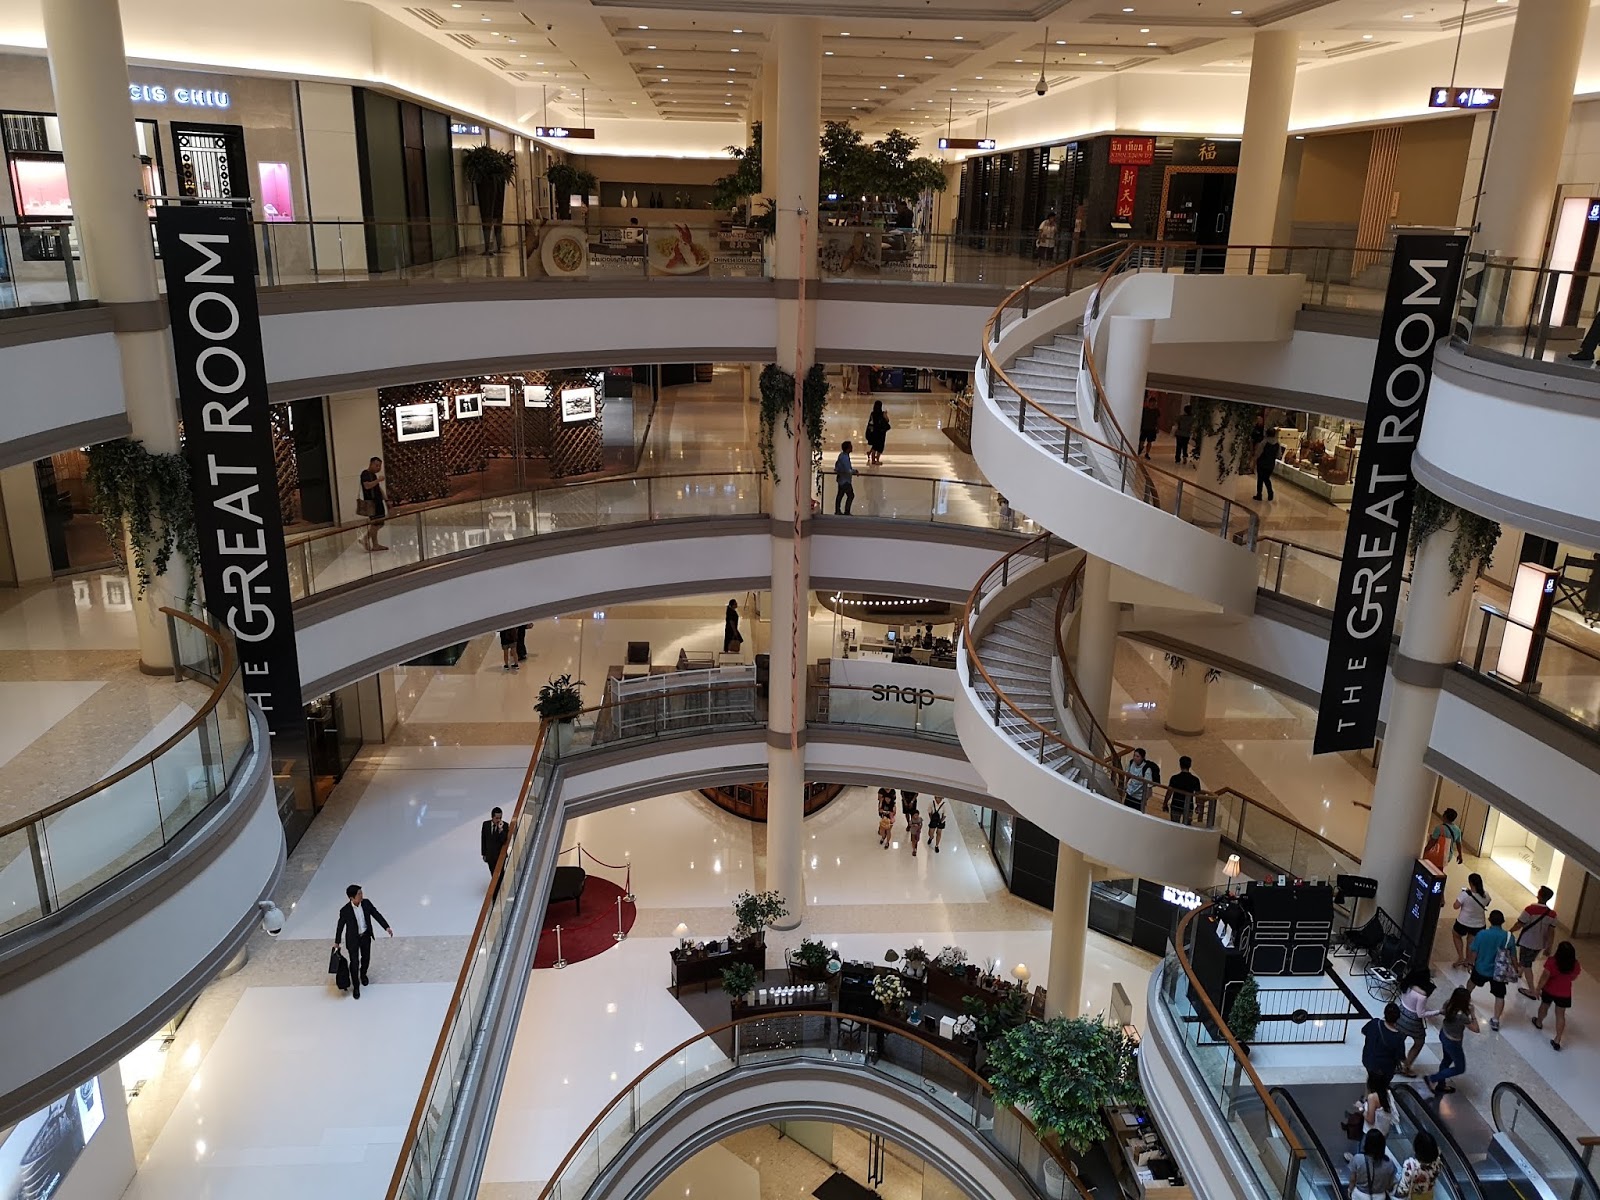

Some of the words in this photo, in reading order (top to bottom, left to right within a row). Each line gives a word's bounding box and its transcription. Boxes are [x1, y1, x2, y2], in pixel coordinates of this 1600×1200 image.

[174, 88, 230, 109] CHIU
[1198, 142, 1217, 161] 福
[1119, 170, 1135, 217] 新天地
[178, 233, 253, 432] ROOM
[1377, 260, 1449, 443] ROOM
[207, 454, 276, 642] GREAT
[1346, 464, 1408, 639] GREAT
[244, 661, 277, 736] HE
[871, 684, 935, 709] snap
[1336, 656, 1368, 733] THE
